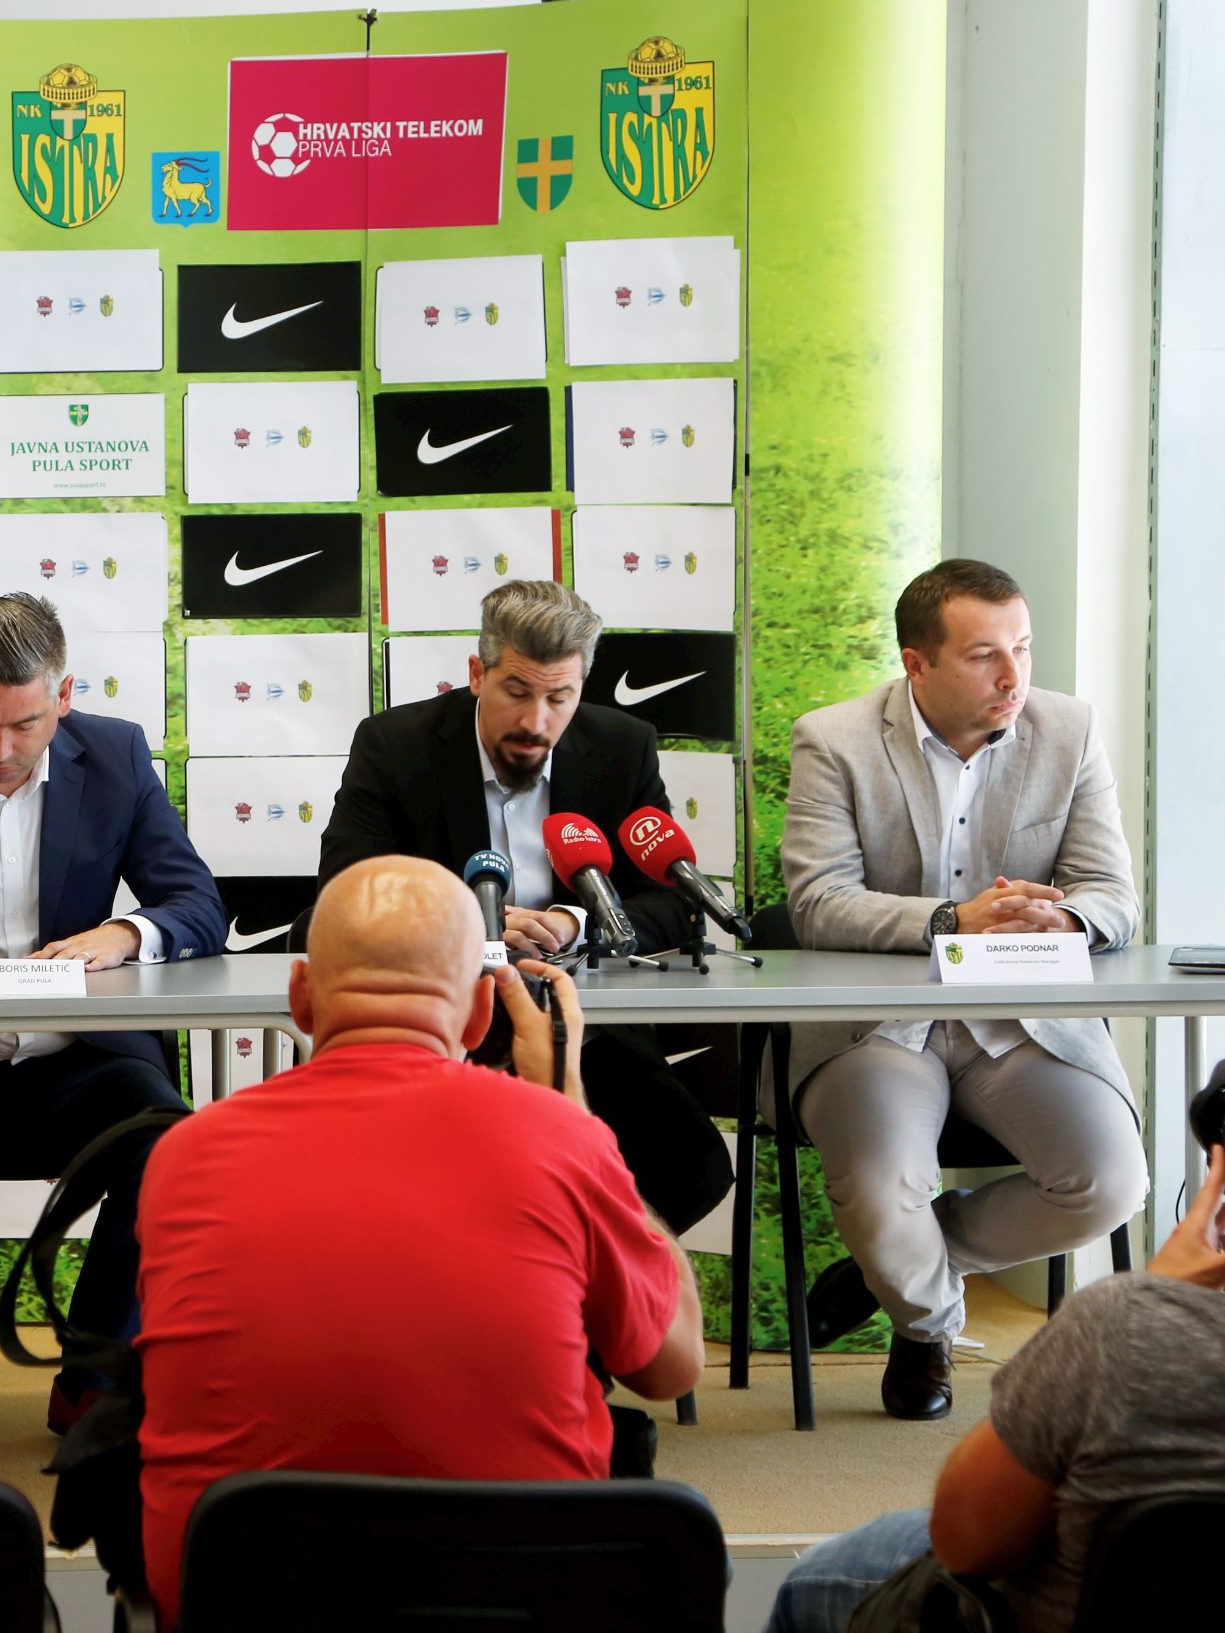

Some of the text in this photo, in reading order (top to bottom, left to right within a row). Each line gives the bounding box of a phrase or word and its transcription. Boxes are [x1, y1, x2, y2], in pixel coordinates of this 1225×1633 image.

[605, 82, 629, 96] NK
[676, 76, 712, 92] 1961
[16, 104, 43, 118] NK
[88, 103, 122, 117] 1961
[298, 119, 484, 140] HRVATSKI TELEKOM
[298, 139, 392, 158] PRVA LIGA
[607, 107, 711, 205] ISTRA
[19, 132, 120, 224] ISTRA
[10, 440, 150, 456] JAVNA USTANOVA
[32, 458, 133, 472] PULA SPORT
[641, 829, 675, 861] nova
[1021, 944, 1059, 952] PODNAR
[0, 964, 70, 973] BORIS MILETIĆ
